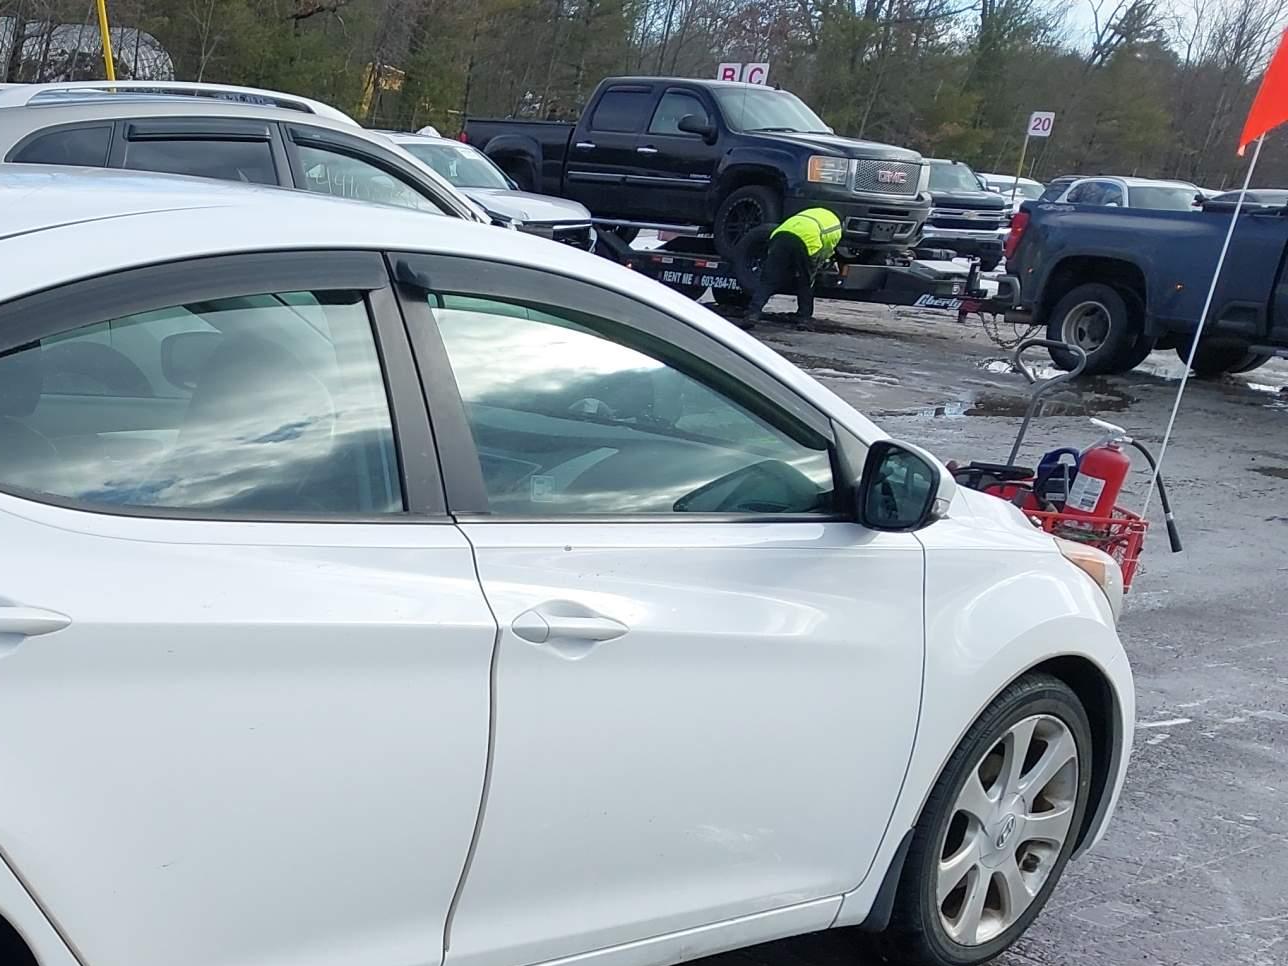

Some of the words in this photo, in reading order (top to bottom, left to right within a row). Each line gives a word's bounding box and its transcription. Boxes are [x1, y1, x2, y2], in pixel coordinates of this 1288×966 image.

[748, 67, 764, 84] C
[1031, 117, 1052, 131] 20
[878, 170, 907, 183] GMC
[663, 270, 682, 283] RENT
[682, 272, 694, 285] ME
[913, 294, 963, 310] Liberty
